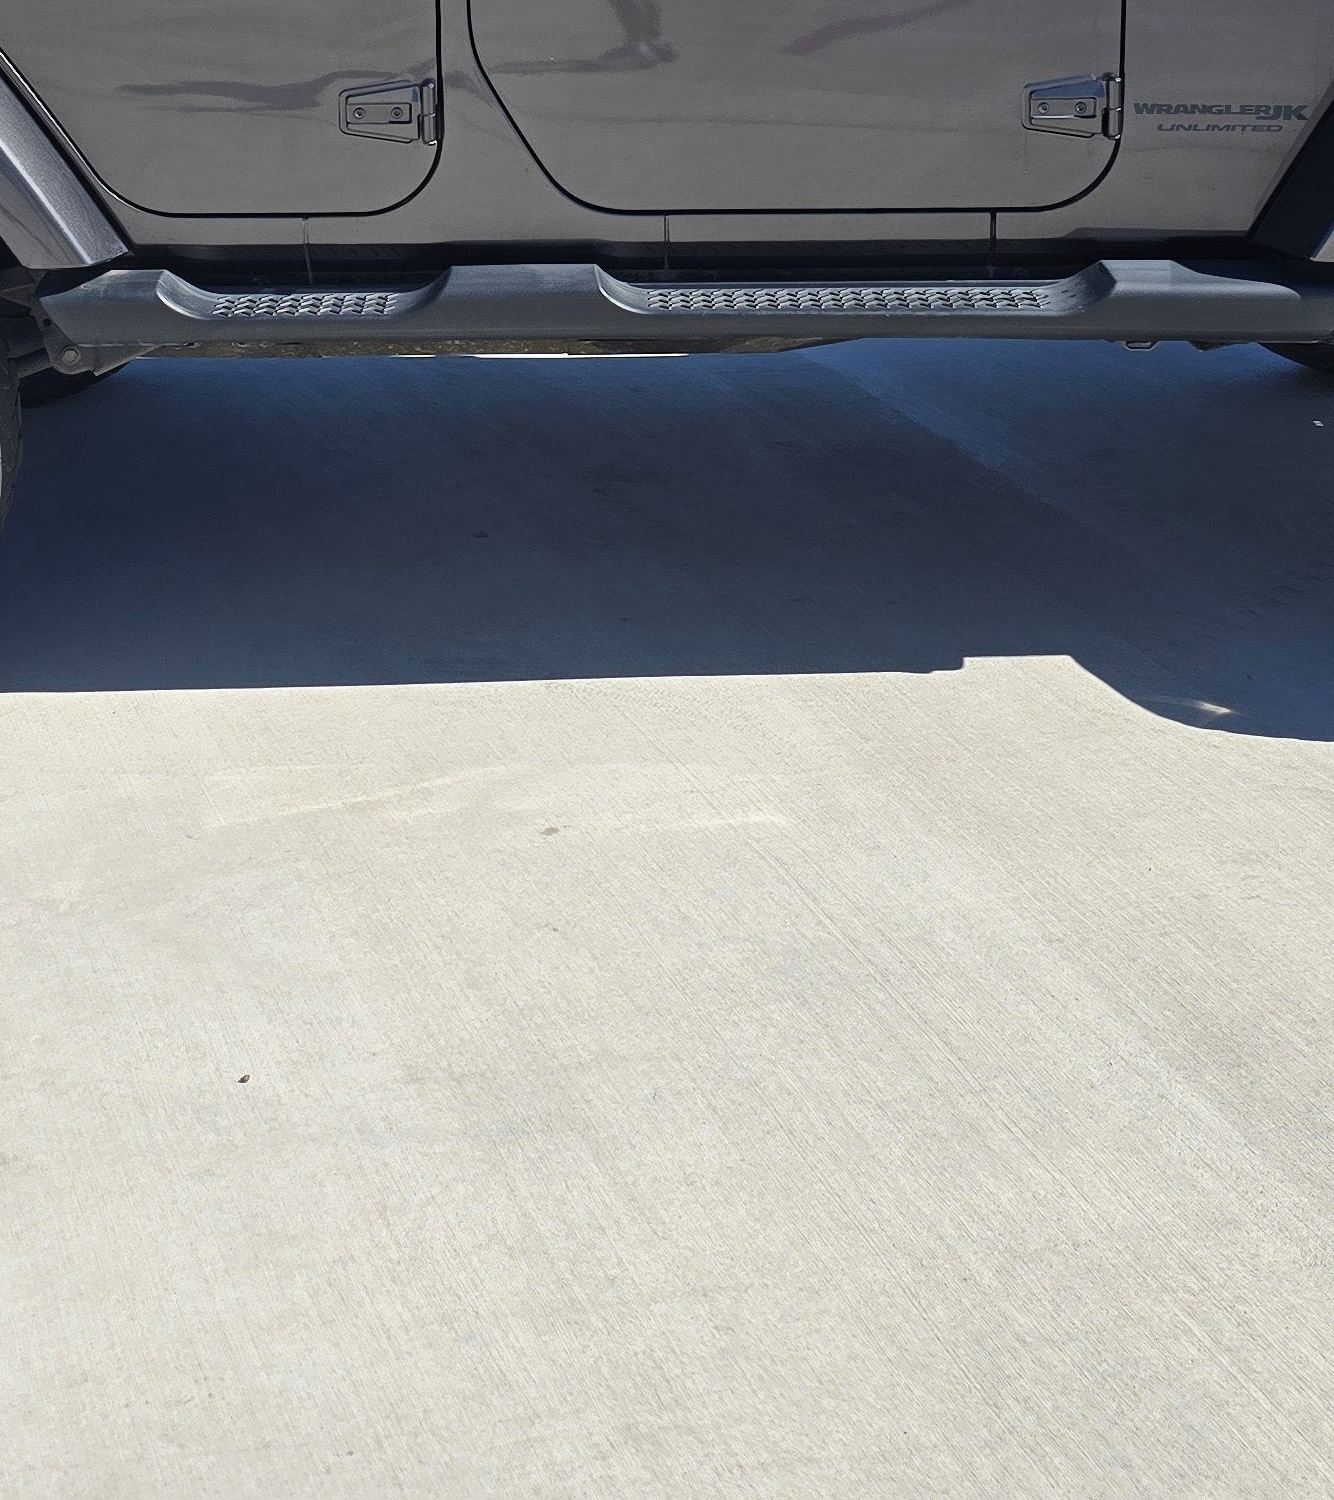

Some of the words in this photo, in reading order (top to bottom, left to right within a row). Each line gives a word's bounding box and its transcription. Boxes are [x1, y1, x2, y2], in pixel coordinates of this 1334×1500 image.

[1133, 102, 1273, 115] WRANGLER
[1255, 104, 1310, 121] JK
[1156, 123, 1283, 133] UNLIMITED
